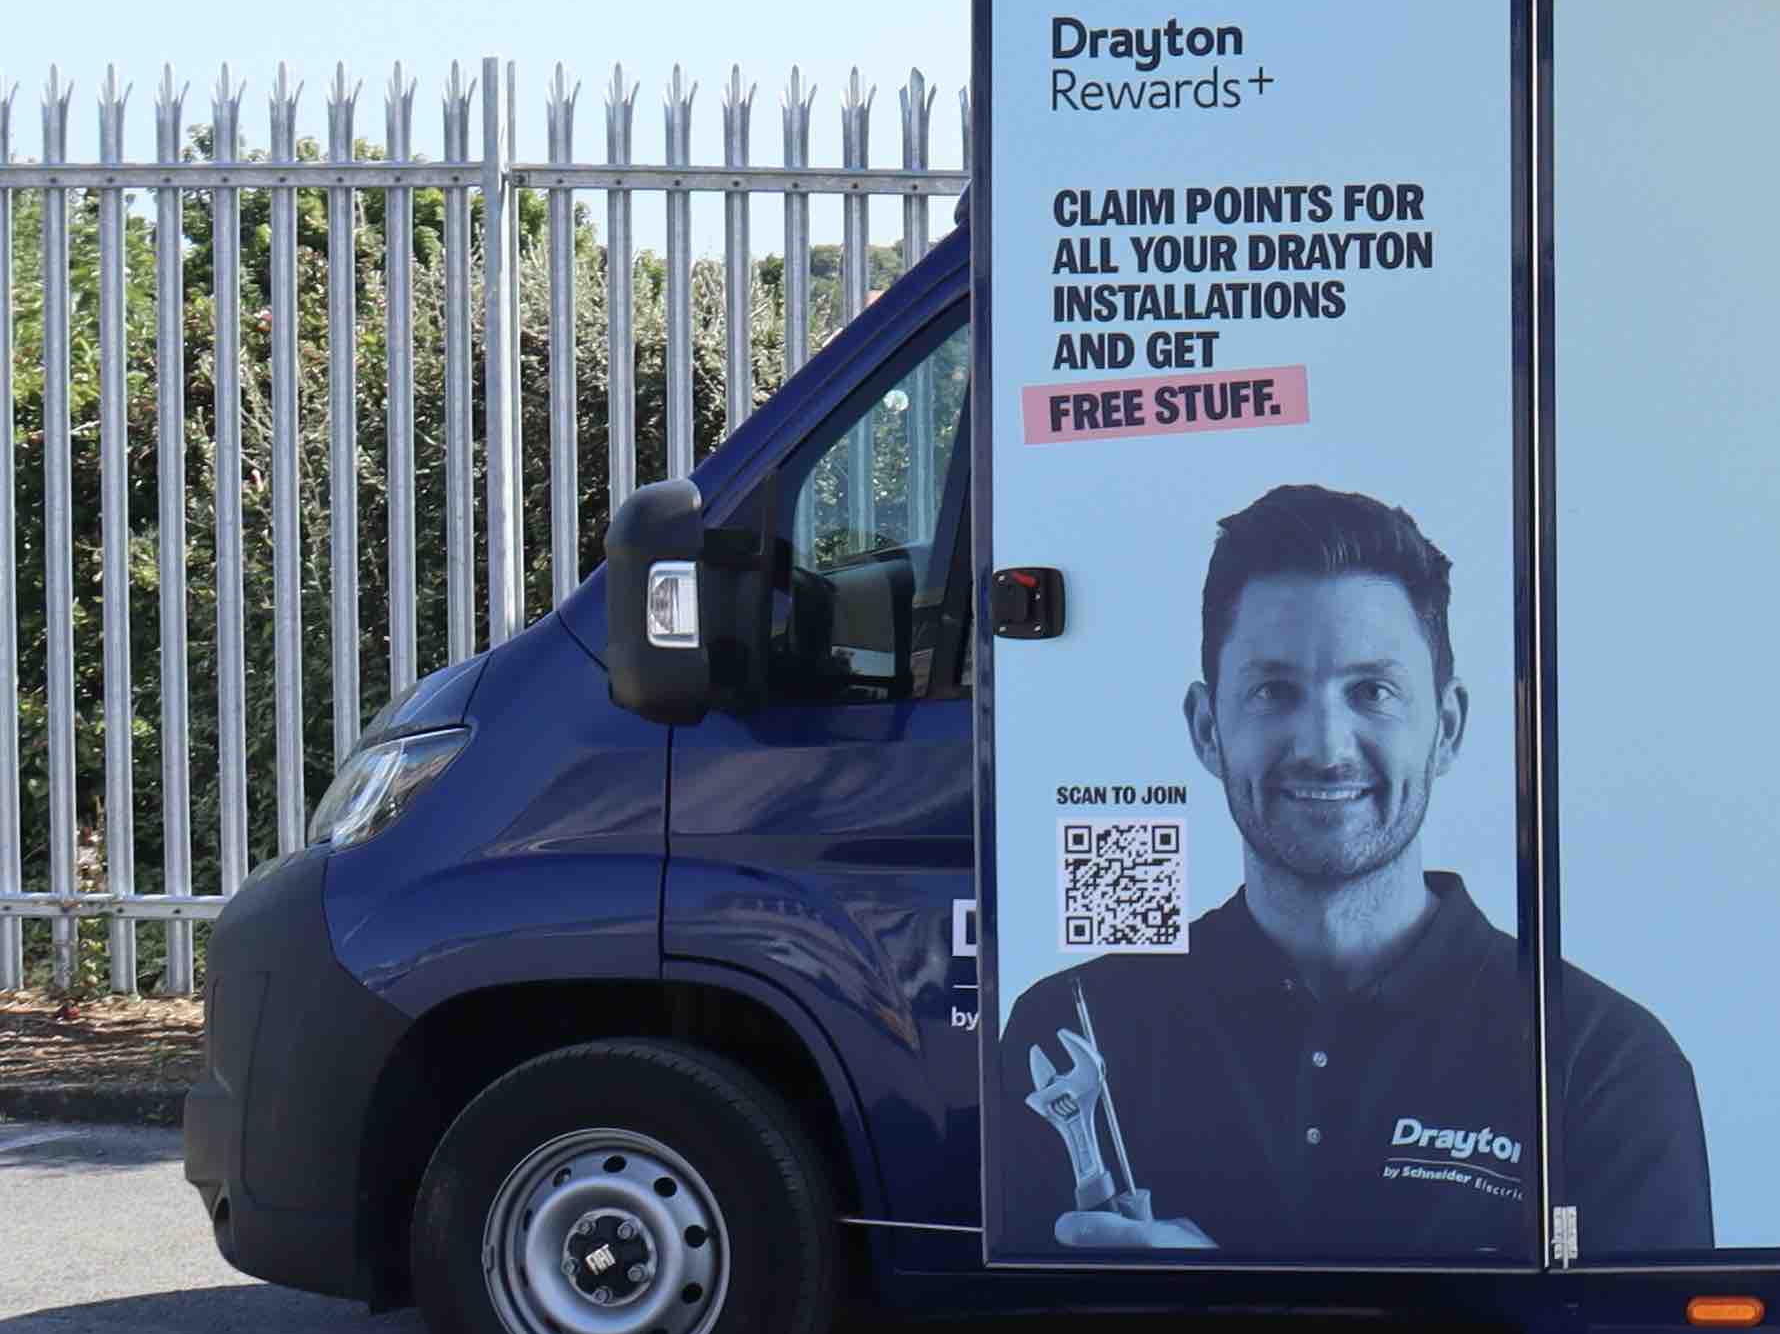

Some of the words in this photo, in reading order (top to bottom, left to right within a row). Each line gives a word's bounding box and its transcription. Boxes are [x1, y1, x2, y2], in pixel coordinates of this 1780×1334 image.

[1052, 18, 1243, 71] Drayton
[1054, 188, 1176, 227] CLAIM
[1187, 185, 1333, 224] POINTS
[1343, 184, 1424, 221] FOR
[1052, 235, 1119, 274] ALL
[1130, 234, 1237, 273] YOUR
[1249, 232, 1433, 271] DRAYTON
[1054, 280, 1346, 323] INSTALLATIONS
[1053, 333, 1134, 371] AND
[1145, 331, 1220, 369] GET
[1049, 386, 1145, 432] FREE
[1155, 379, 1281, 424] STUFF.
[1056, 786, 1106, 805] SCAN
[1112, 786, 1136, 805] TO
[1142, 786, 1187, 805] JOIN
[951, 1006, 979, 1031] by
[1383, 1166, 1400, 1179] by
[1402, 1165, 1472, 1184] Schneider
[585, 1243, 616, 1275] FIAT
